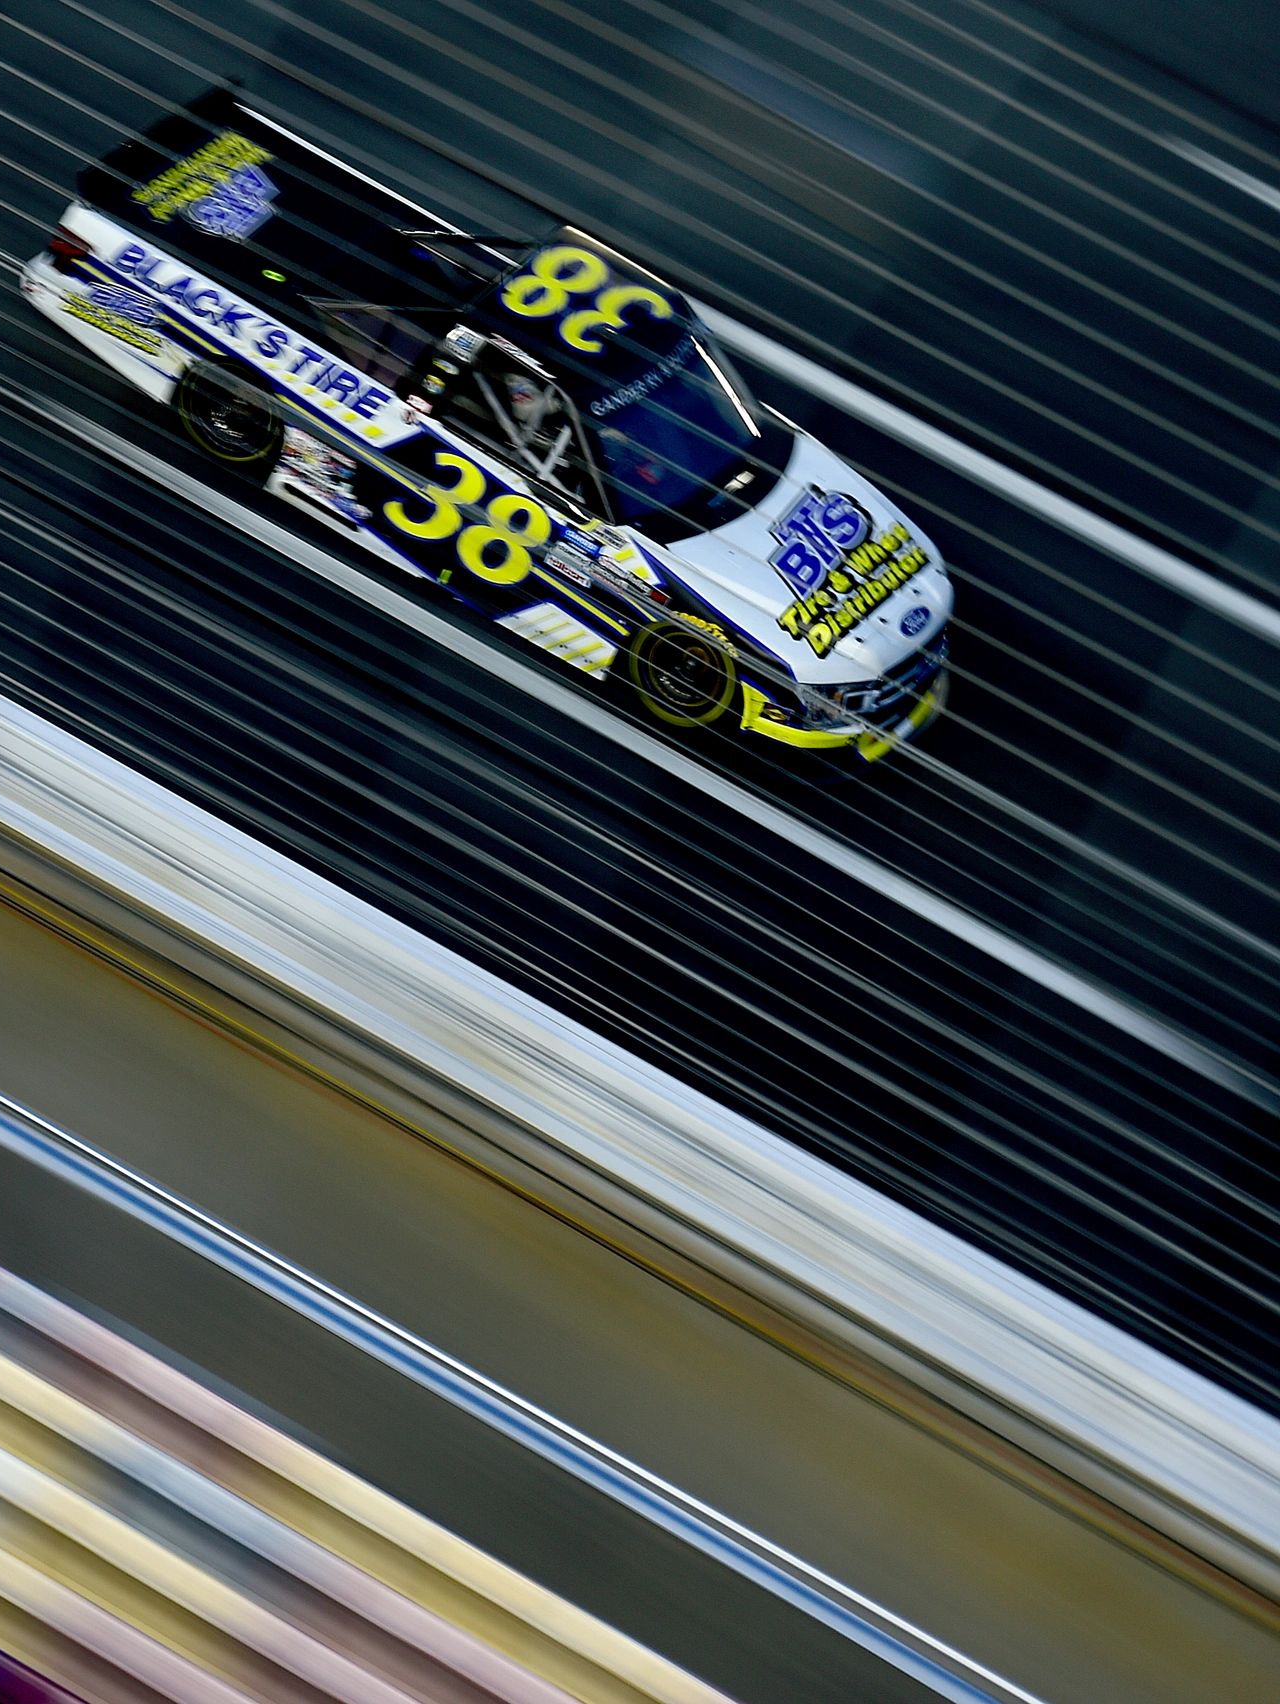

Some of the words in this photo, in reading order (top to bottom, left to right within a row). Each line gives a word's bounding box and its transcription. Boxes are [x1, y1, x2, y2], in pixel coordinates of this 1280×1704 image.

[116, 242, 290, 359] BLACK'S
[287, 344, 394, 421] TIRE
[500, 246, 674, 353] 38
[382, 452, 552, 585] 38
[769, 488, 869, 598] BTS
[778, 588, 833, 637] Tire
[827, 568, 853, 593] &
[844, 521, 911, 576] Whee
